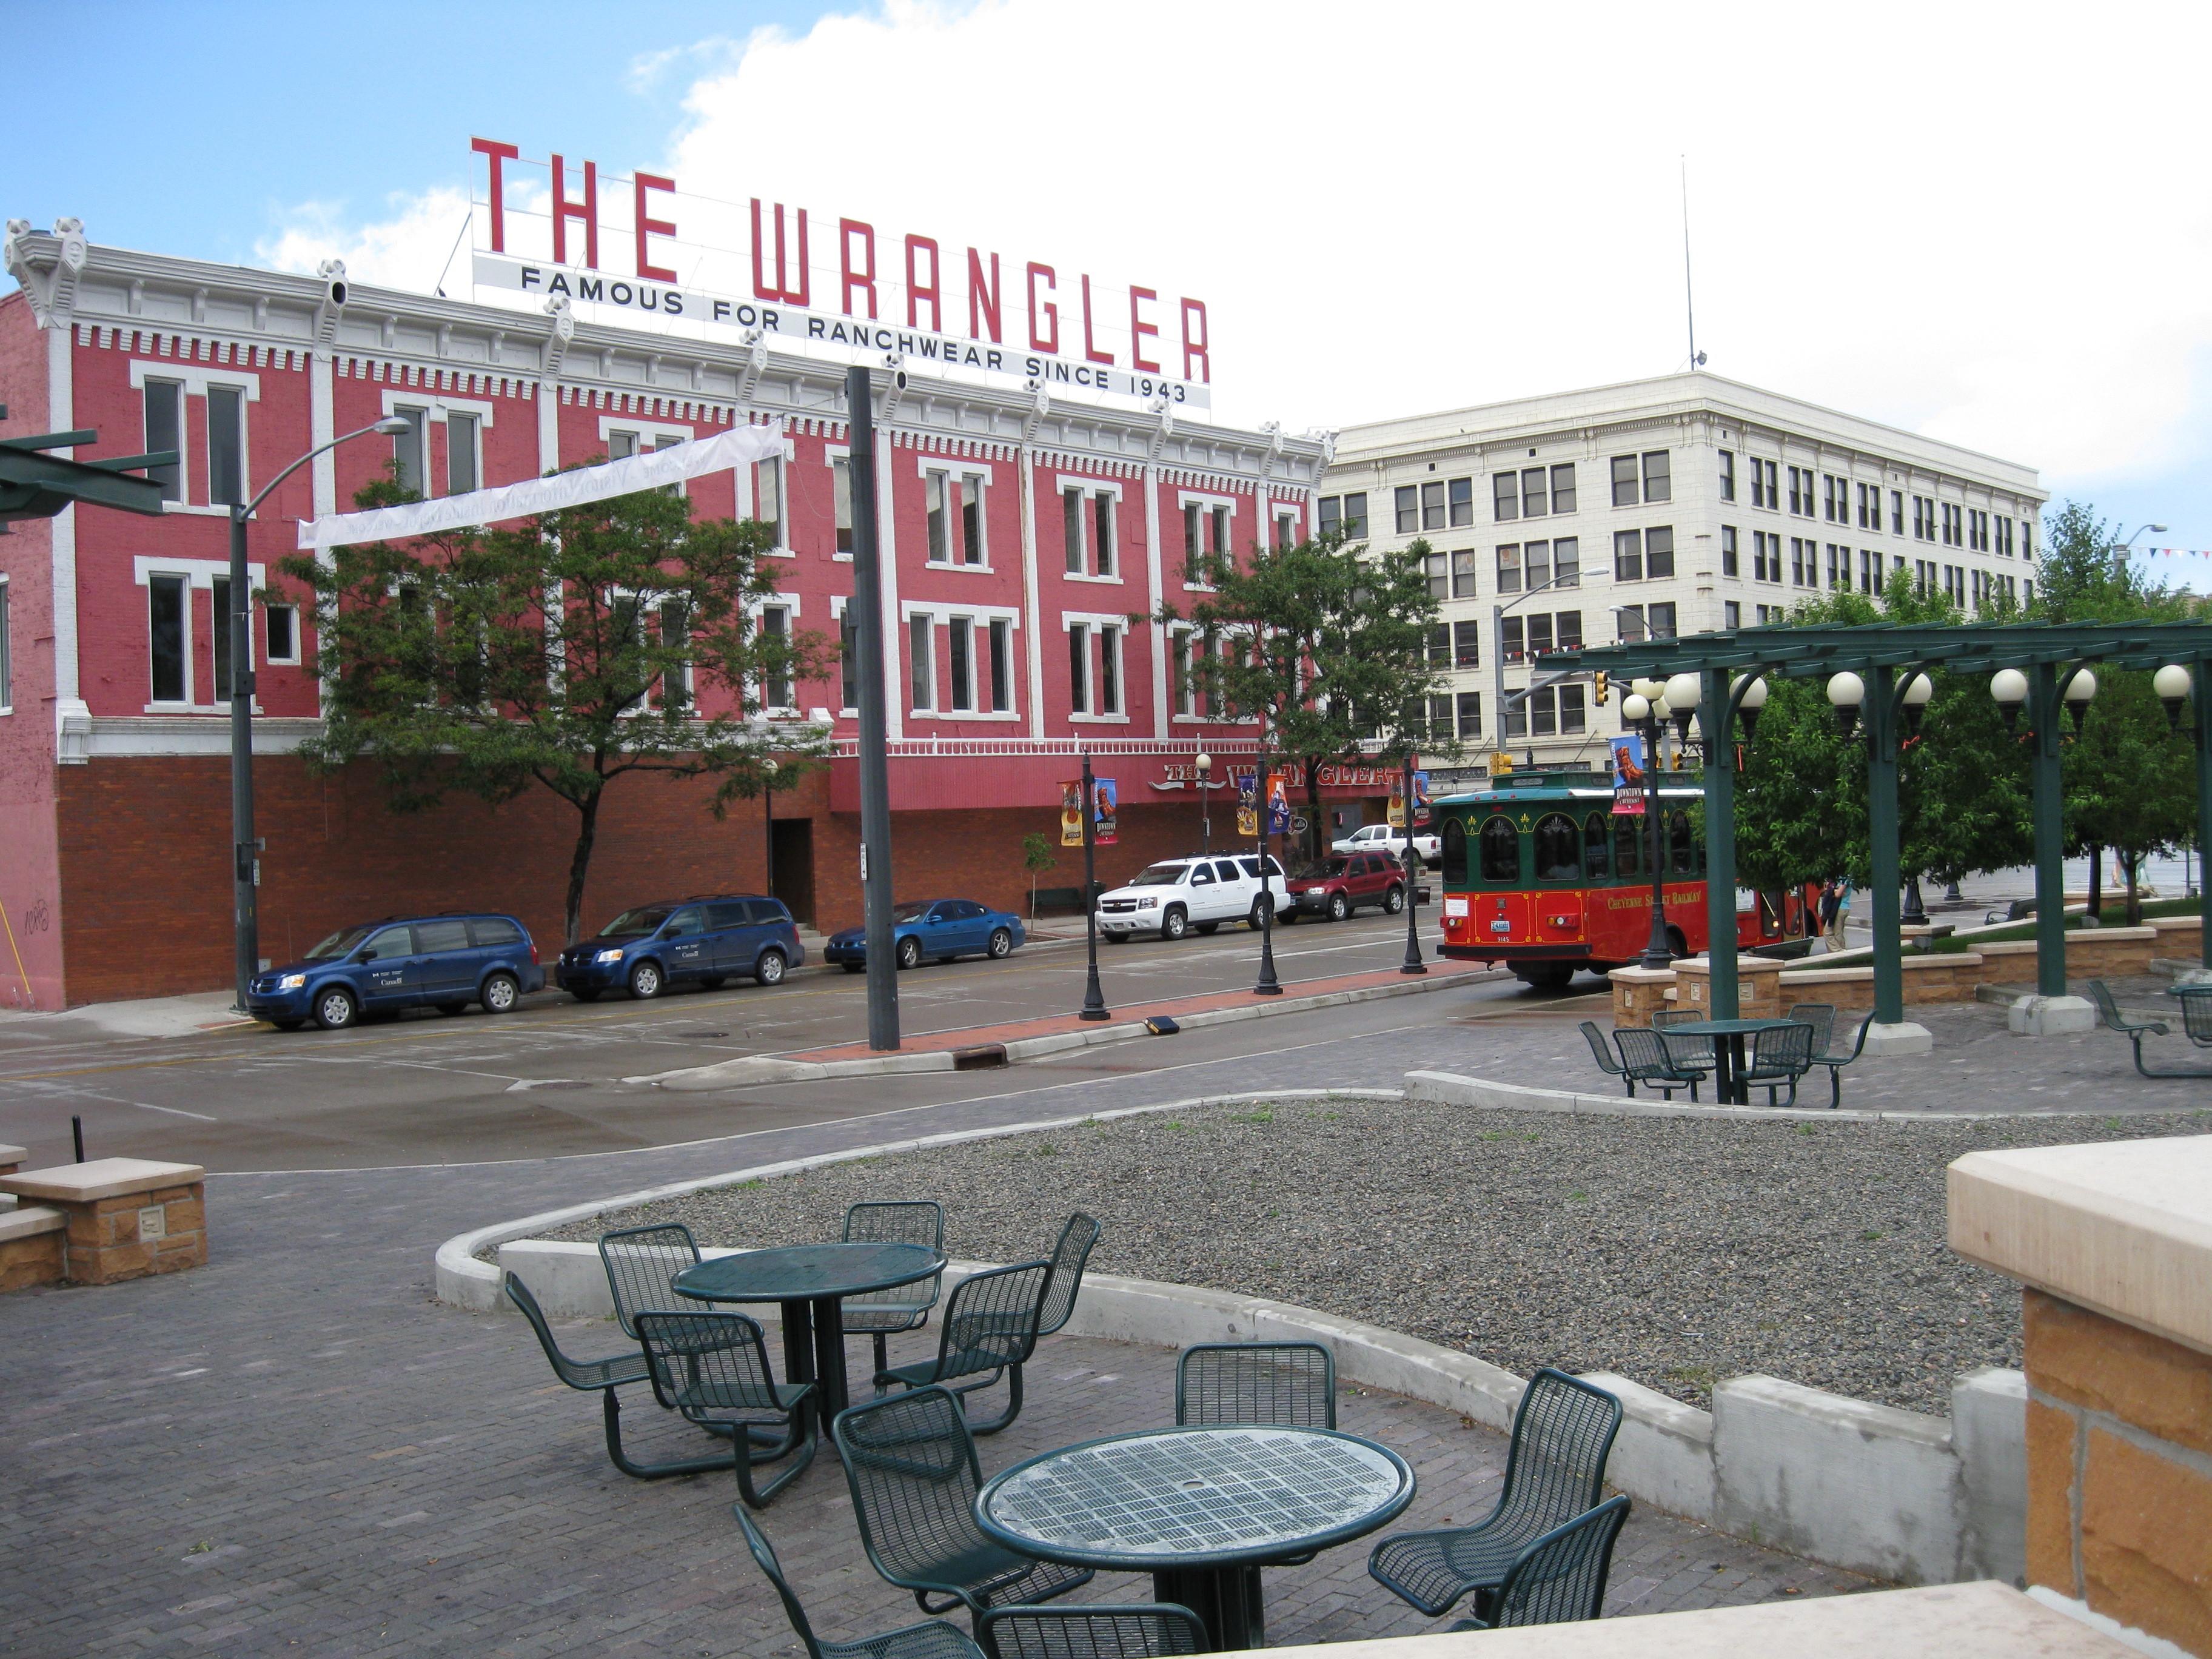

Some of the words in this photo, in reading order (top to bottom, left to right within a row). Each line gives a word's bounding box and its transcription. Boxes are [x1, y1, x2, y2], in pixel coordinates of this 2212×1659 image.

[471, 136, 677, 284] THE
[750, 196, 1210, 384] WRANGLER
[521, 266, 683, 315] FAMOUS
[713, 300, 779, 332] FOR
[808, 317, 1002, 370] RANCHWEAR
[1026, 357, 1109, 389] SINCE
[1130, 377, 1185, 403] 1943
[1616, 788, 1642, 799] DOWNTOWN
